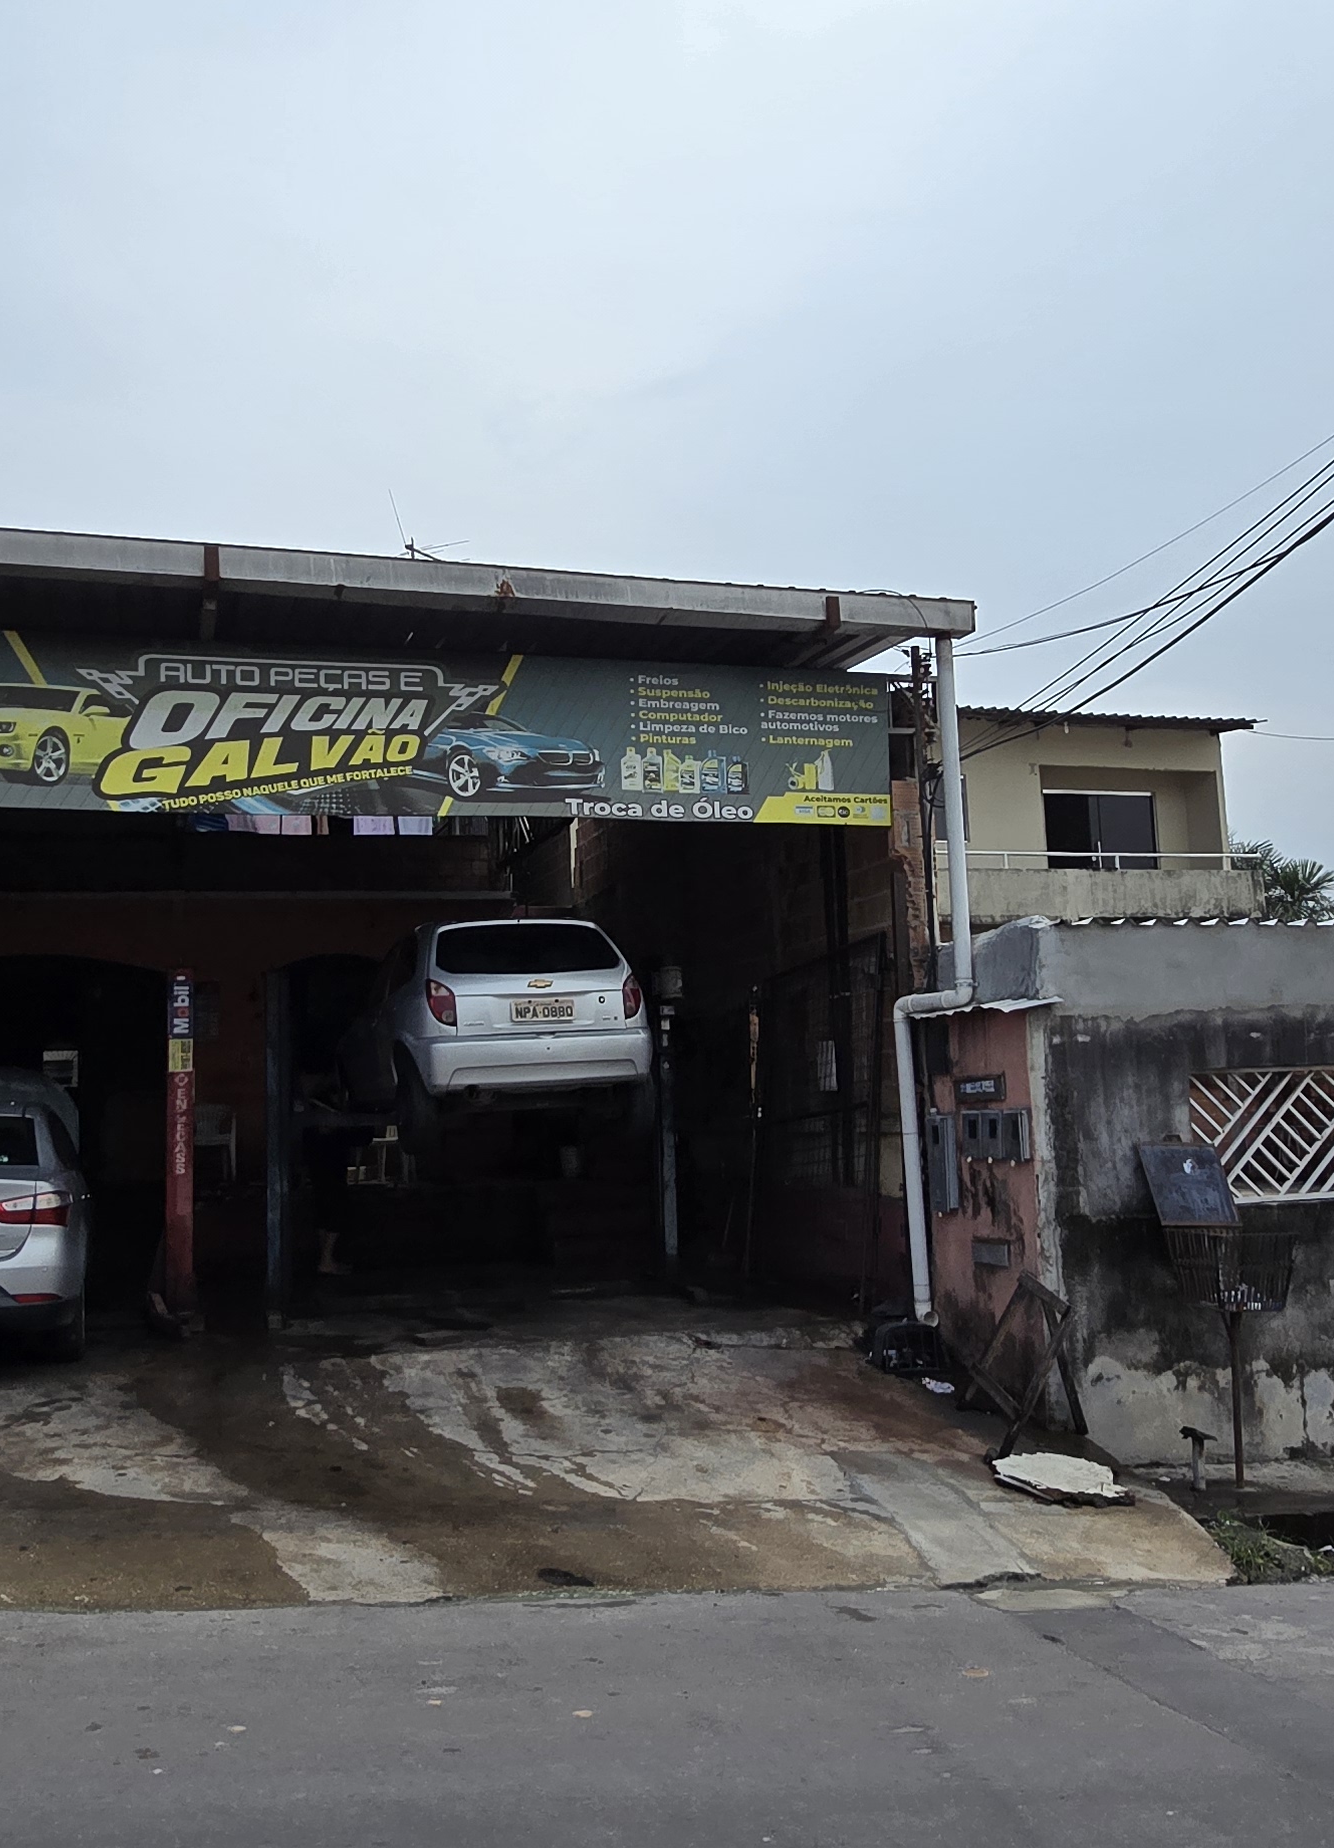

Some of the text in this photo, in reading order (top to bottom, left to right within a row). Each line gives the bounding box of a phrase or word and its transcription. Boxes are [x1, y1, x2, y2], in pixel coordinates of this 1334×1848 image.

[159, 662, 424, 693] AUTO PEÇAS E
[638, 675, 679, 686] Freios
[638, 686, 710, 699] Suspensão
[767, 680, 813, 693] Injeção
[638, 698, 720, 712] Embreagem
[128, 690, 430, 750] OFICINA
[639, 710, 723, 722] Computador
[768, 710, 878, 723] Fazemos motores
[639, 721, 748, 735] Limpeza de Bico
[760, 721, 840, 732] automotivos
[640, 733, 697, 745] Pinturas
[769, 735, 853, 748] Lanternagem
[99, 730, 421, 796] GALVÃO
[162, 766, 413, 812] TUDO POSSO NAQUELE QUE ME FORTALECE
[803, 794, 888, 804] Aceitamos Cartões
[565, 797, 754, 820] Troca de Óleo
[173, 985, 190, 1034] Mobil
